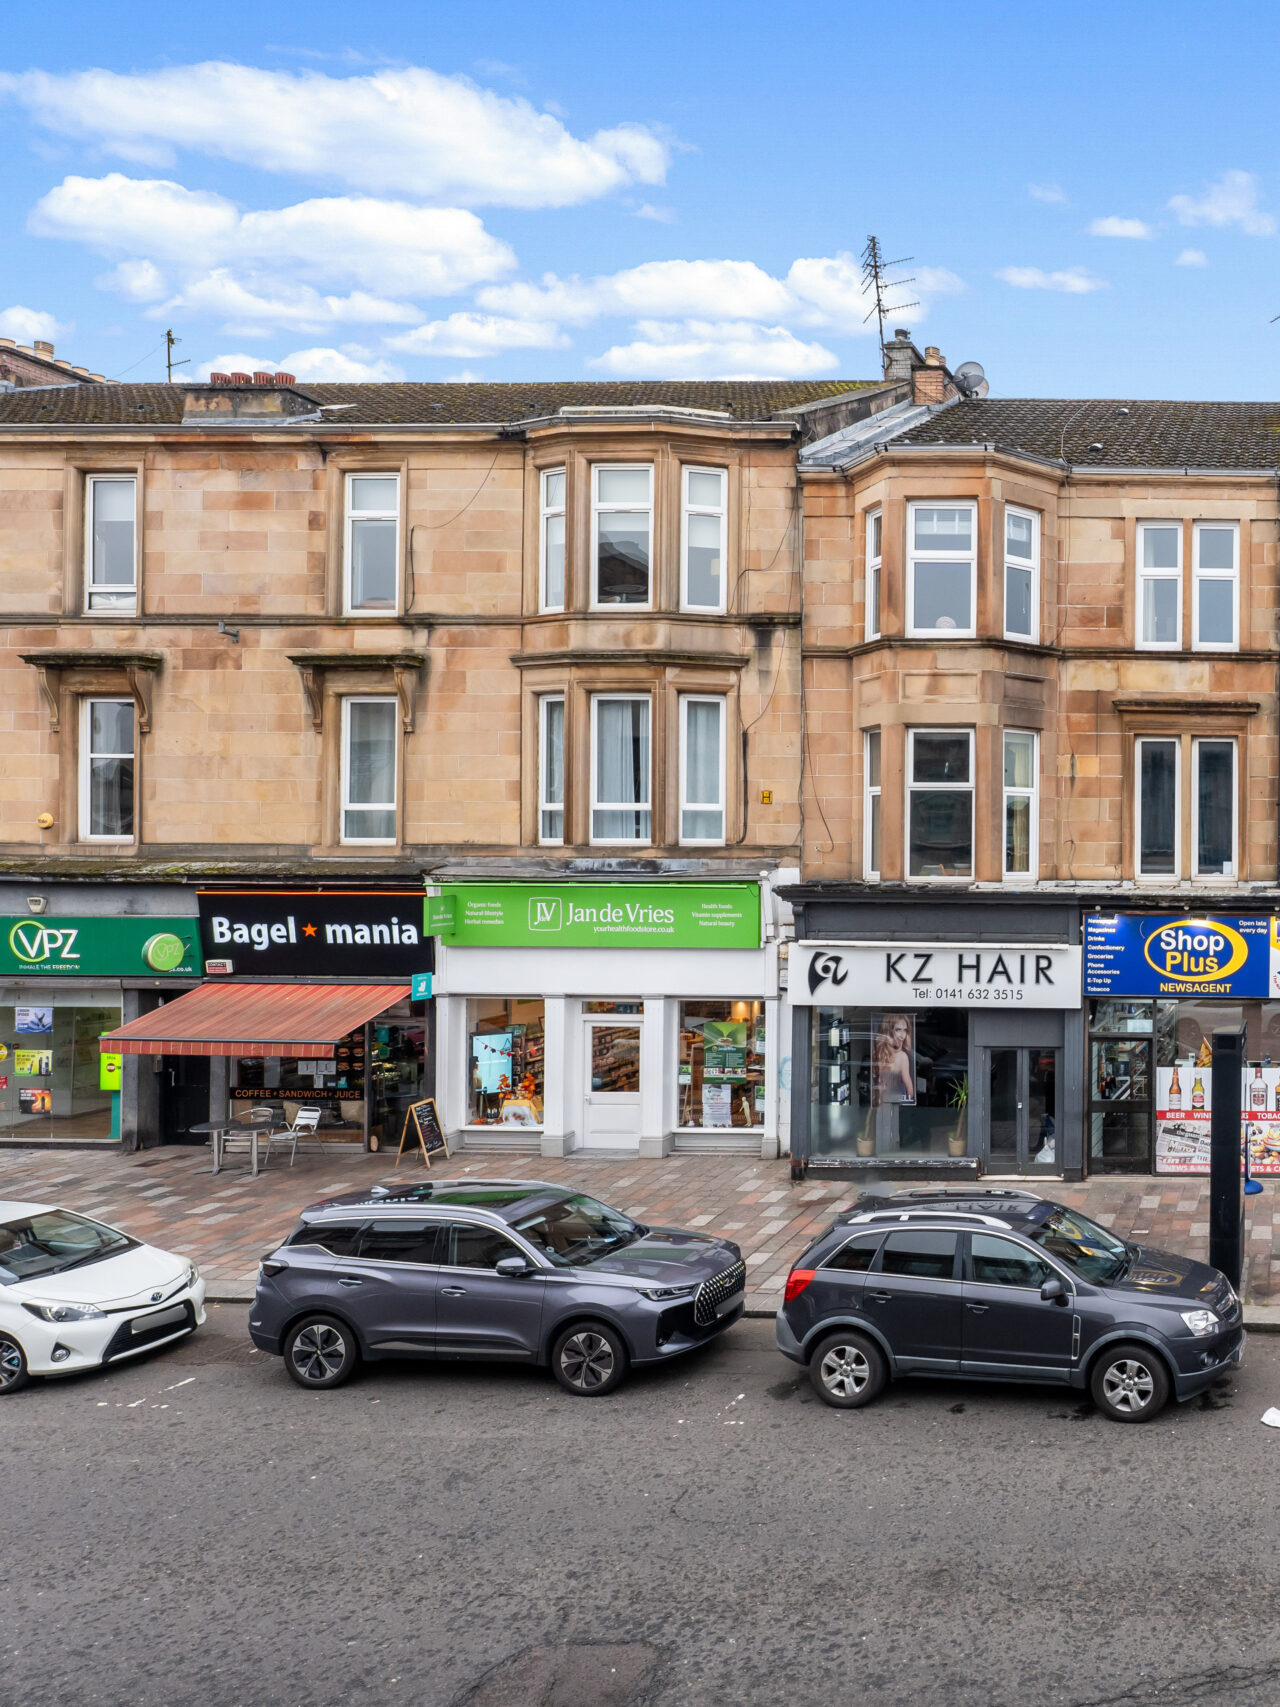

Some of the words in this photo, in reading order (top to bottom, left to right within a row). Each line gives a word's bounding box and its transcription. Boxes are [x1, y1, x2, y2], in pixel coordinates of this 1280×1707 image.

[566, 902, 597, 926] Jan
[599, 903, 623, 922] de
[625, 903, 675, 924] Vries
[593, 925, 675, 933] yourhealthfoodstore.co.uk
[1238, 920, 1255, 928] Open
[211, 916, 297, 950] Bagel
[324, 916, 419, 945] mania
[1256, 927, 1268, 935] day
[16, 929, 81, 958] VPZ
[1087, 944, 1125, 952] Confectionery
[1160, 929, 1225, 956] Shop
[1165, 951, 1219, 973] Plus
[886, 953, 934, 983] KZ
[957, 953, 1055, 985] HAIR
[912, 988, 932, 999] Tel:
[935, 988, 963, 999] 0141
[967, 989, 990, 1000] 632
[993, 989, 1023, 1001] 3515
[1159, 983, 1232, 993] NEWSAGENT
[235, 1089, 272, 1098] COFFEE
[278, 1090, 328, 1098] SANDWICH
[334, 1090, 361, 1099] JUICE
